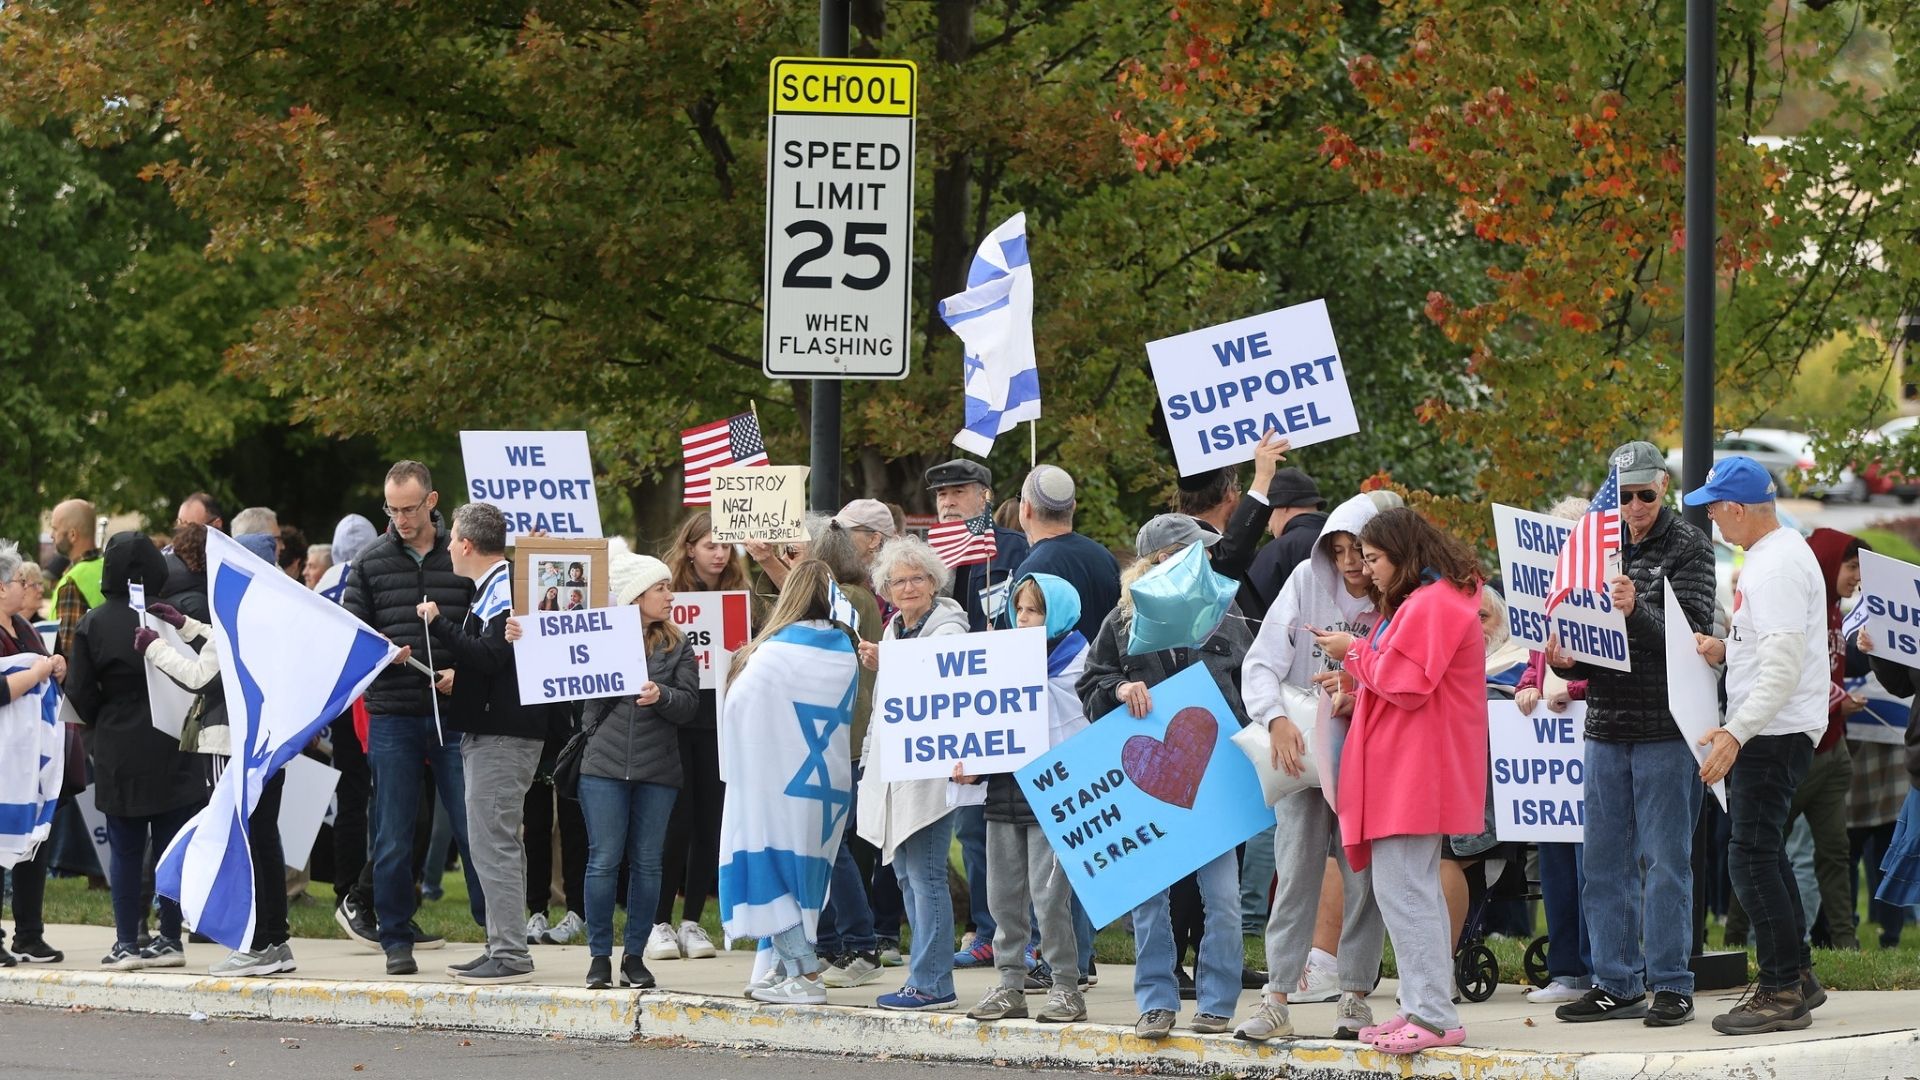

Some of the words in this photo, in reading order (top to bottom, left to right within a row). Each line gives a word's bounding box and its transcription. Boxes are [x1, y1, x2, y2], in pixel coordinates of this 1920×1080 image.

[782, 74, 905, 105] SCHOOL
[783, 140, 901, 171] SPEED
[795, 181, 886, 211] LIMIT
[782, 219, 891, 291] 25
[805, 313, 869, 333] WHEN
[779, 336, 893, 356] FLASHING
[1211, 331, 1272, 367] WE
[1167, 354, 1337, 421] SUPPORT
[1197, 401, 1331, 455] ISRAEL
[505, 446, 546, 467] WE
[471, 478, 591, 500] SUPPORT
[715, 475, 786, 491] DESTROY
[723, 497, 752, 513] NAZI
[729, 499, 787, 529] HAMAS!
[502, 512, 584, 533] SRAEL
[718, 532, 746, 541] STAND
[749, 530, 769, 540] WITH
[769, 527, 801, 540] ISRAEL
[1514, 517, 1572, 557] ISRAE
[540, 611, 613, 637] ISRAEL
[1508, 605, 1552, 643] BEST
[1557, 617, 1626, 661] FRIEND
[569, 644, 590, 665] IS
[935, 648, 988, 678] WE
[542, 672, 625, 698] STRONG
[883, 685, 1044, 724] SUPPORT
[904, 728, 1026, 763] ISRAEL
[1532, 718, 1575, 744] WE
[1032, 760, 1069, 792] WE
[1494, 758, 1584, 785] SUPPO
[1050, 768, 1125, 823] STAND
[1062, 803, 1121, 850] WITH
[1512, 799, 1584, 826] ISRA
[1083, 822, 1168, 879] ISRAEL
